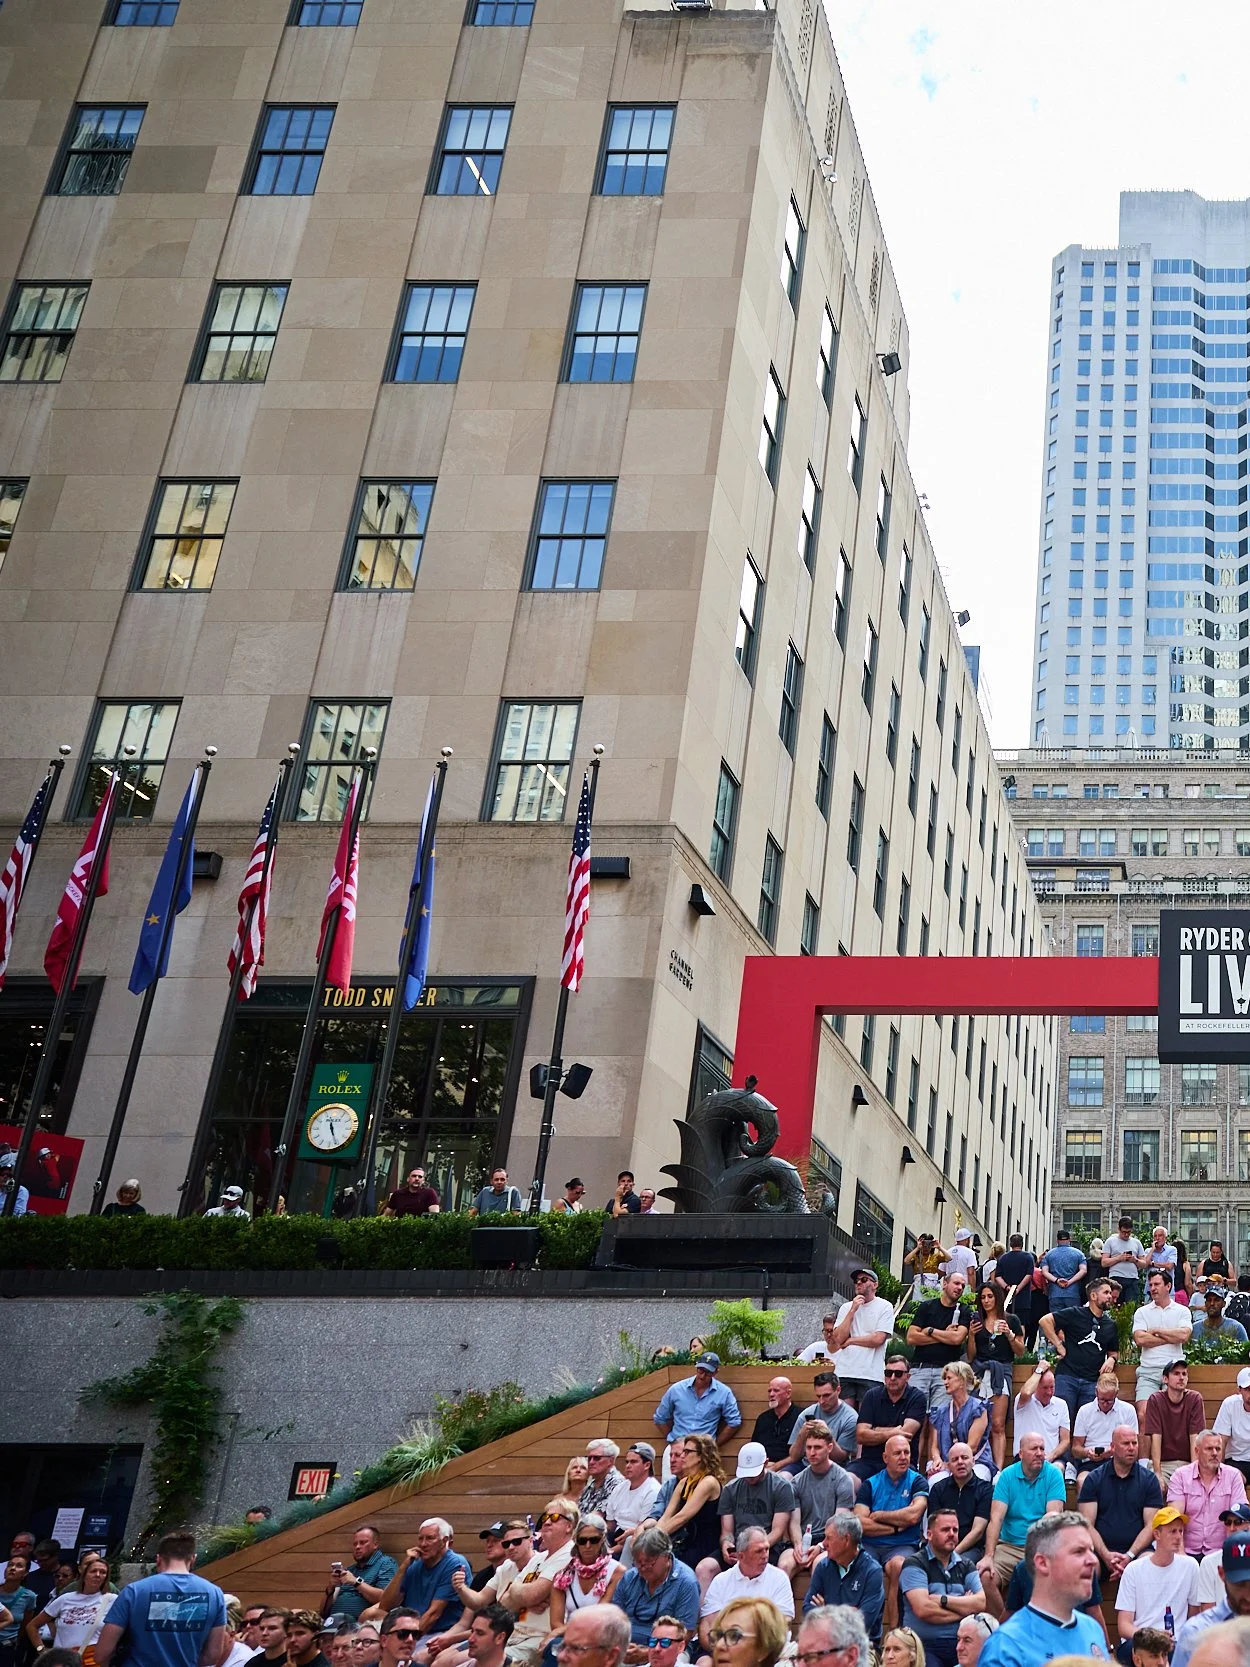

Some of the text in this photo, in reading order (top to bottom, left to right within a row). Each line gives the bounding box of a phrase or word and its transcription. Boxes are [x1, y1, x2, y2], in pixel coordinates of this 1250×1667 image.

[1180, 927, 1245, 950] RYDER
[671, 949, 694, 980] CHANNEL
[323, 987, 437, 1007] TODD SNER
[318, 1085, 362, 1094] ROLEX
[297, 1470, 330, 1493] EXIT
